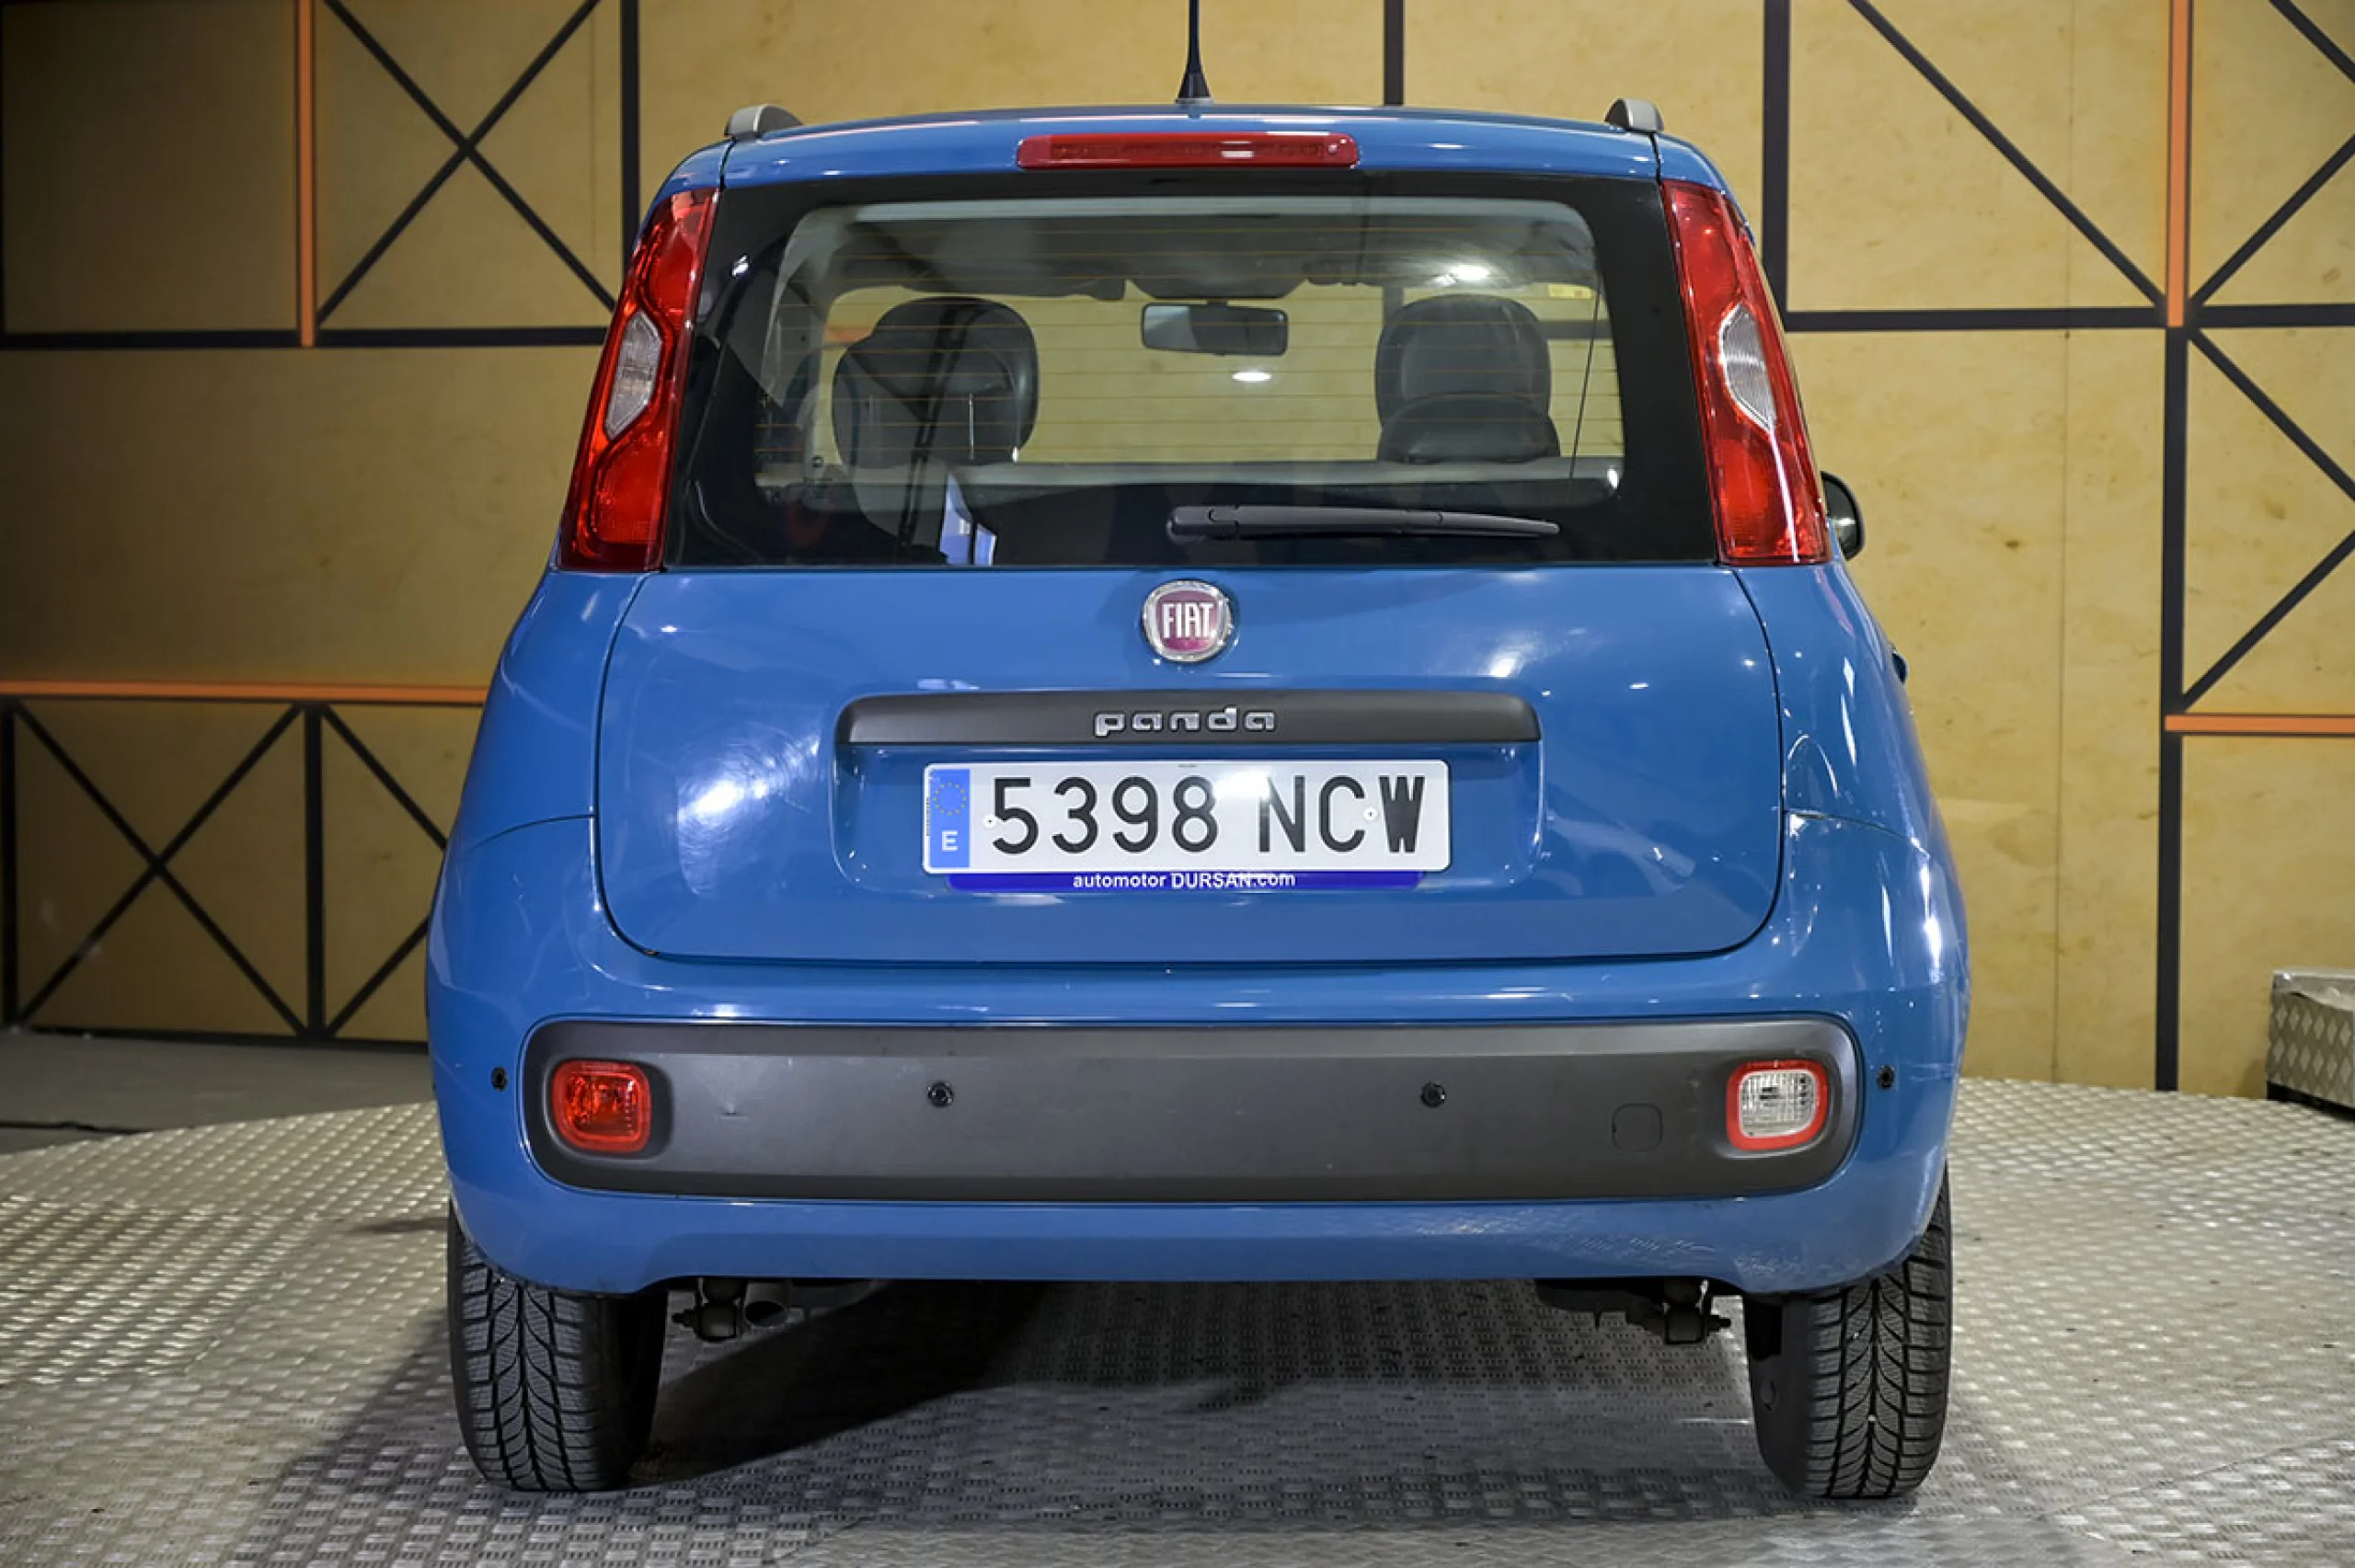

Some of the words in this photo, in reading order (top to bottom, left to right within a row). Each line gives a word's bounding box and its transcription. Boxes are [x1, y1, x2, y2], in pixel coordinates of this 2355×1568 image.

[1162, 602, 1213, 638] FIAT
[1095, 706, 1275, 737] panda
[992, 775, 1219, 854] 5398
[1258, 775, 1425, 854] NCW
[941, 830, 959, 852] E
[1073, 873, 1166, 888] automotor
[1170, 871, 1296, 890] DURSAN.com
